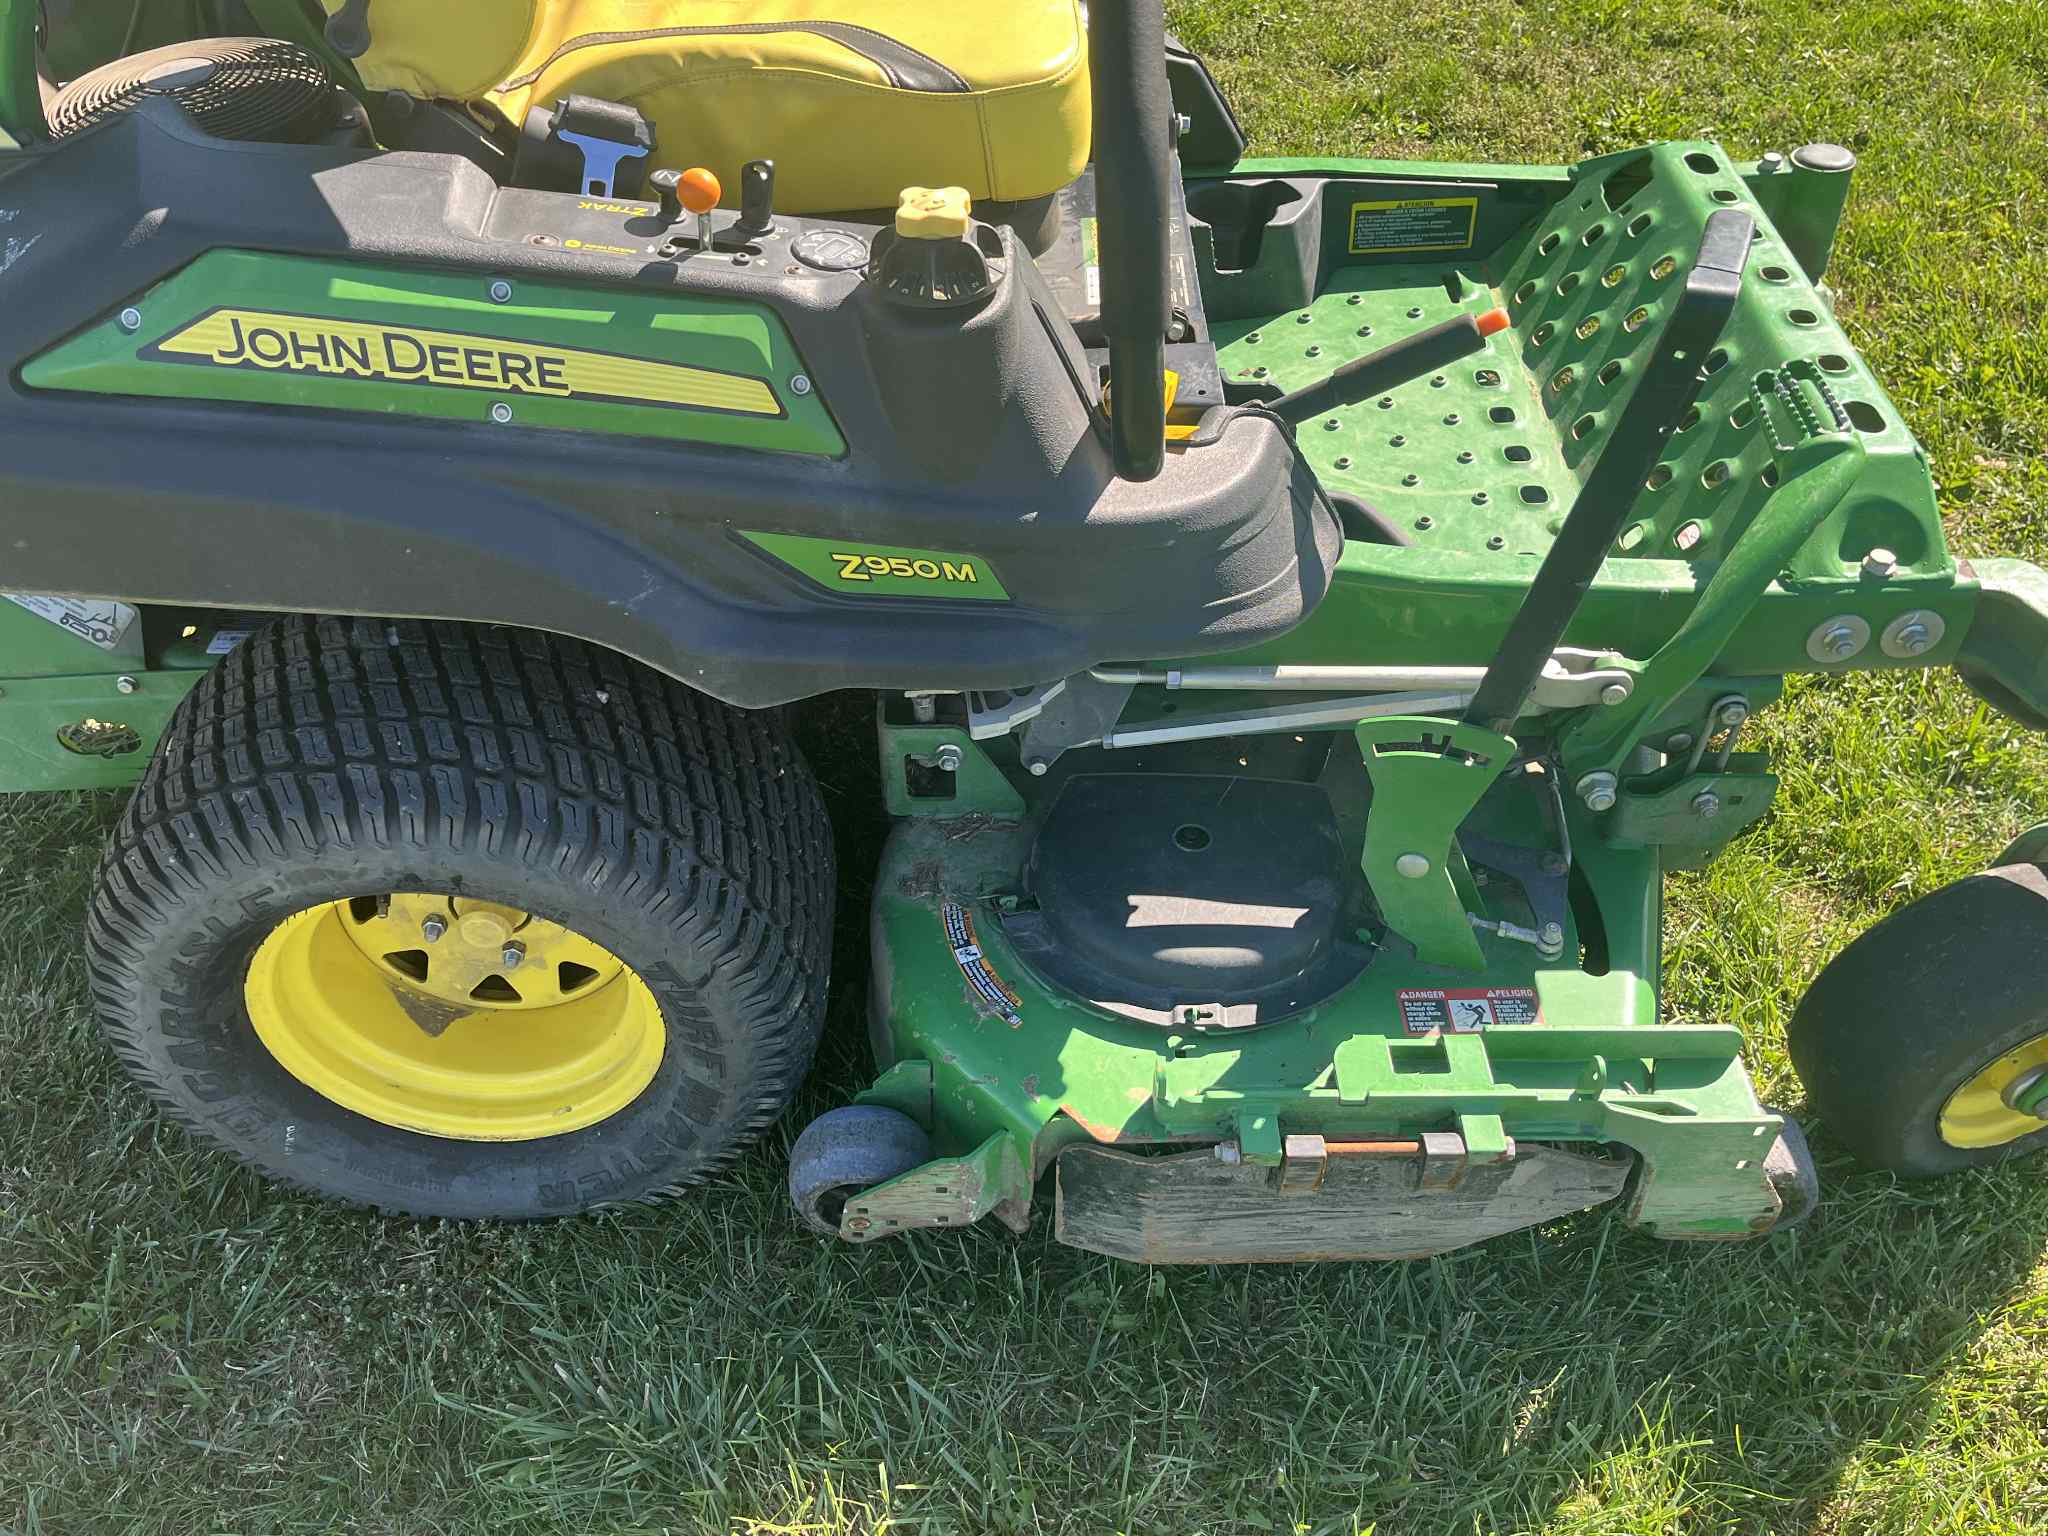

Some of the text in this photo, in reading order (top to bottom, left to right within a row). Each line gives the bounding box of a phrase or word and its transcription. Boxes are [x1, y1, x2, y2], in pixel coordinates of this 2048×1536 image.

[577, 200, 649, 217] ZTRAK
[217, 317, 571, 390] JOHN DEERE
[830, 552, 978, 583] Z950M
[1408, 991, 1446, 999] DANGER
[1495, 988, 1533, 998] PELIGRO
